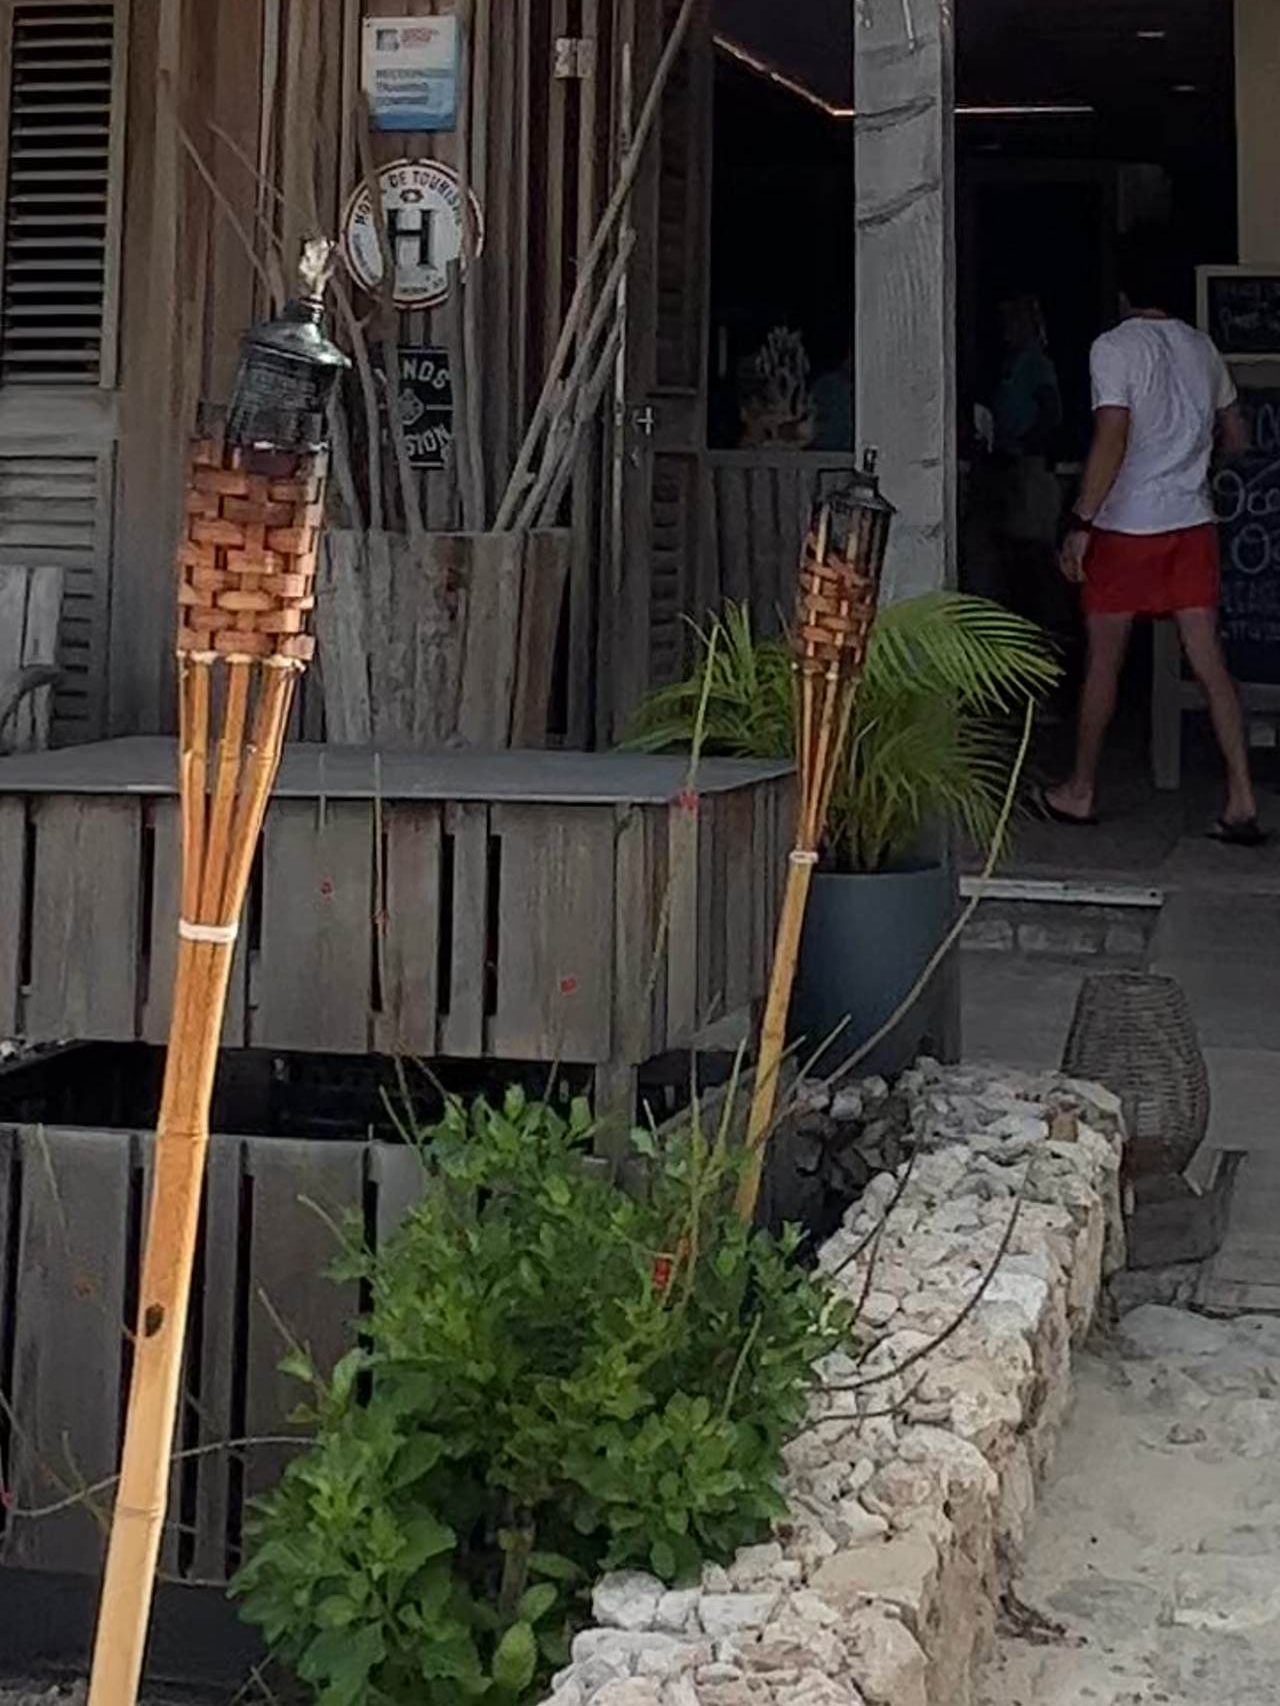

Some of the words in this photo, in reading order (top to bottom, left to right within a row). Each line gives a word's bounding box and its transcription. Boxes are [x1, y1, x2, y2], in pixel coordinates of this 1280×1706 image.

[386, 208, 438, 270] H
[403, 358, 451, 389] NDS
[403, 424, 454, 457] SION
